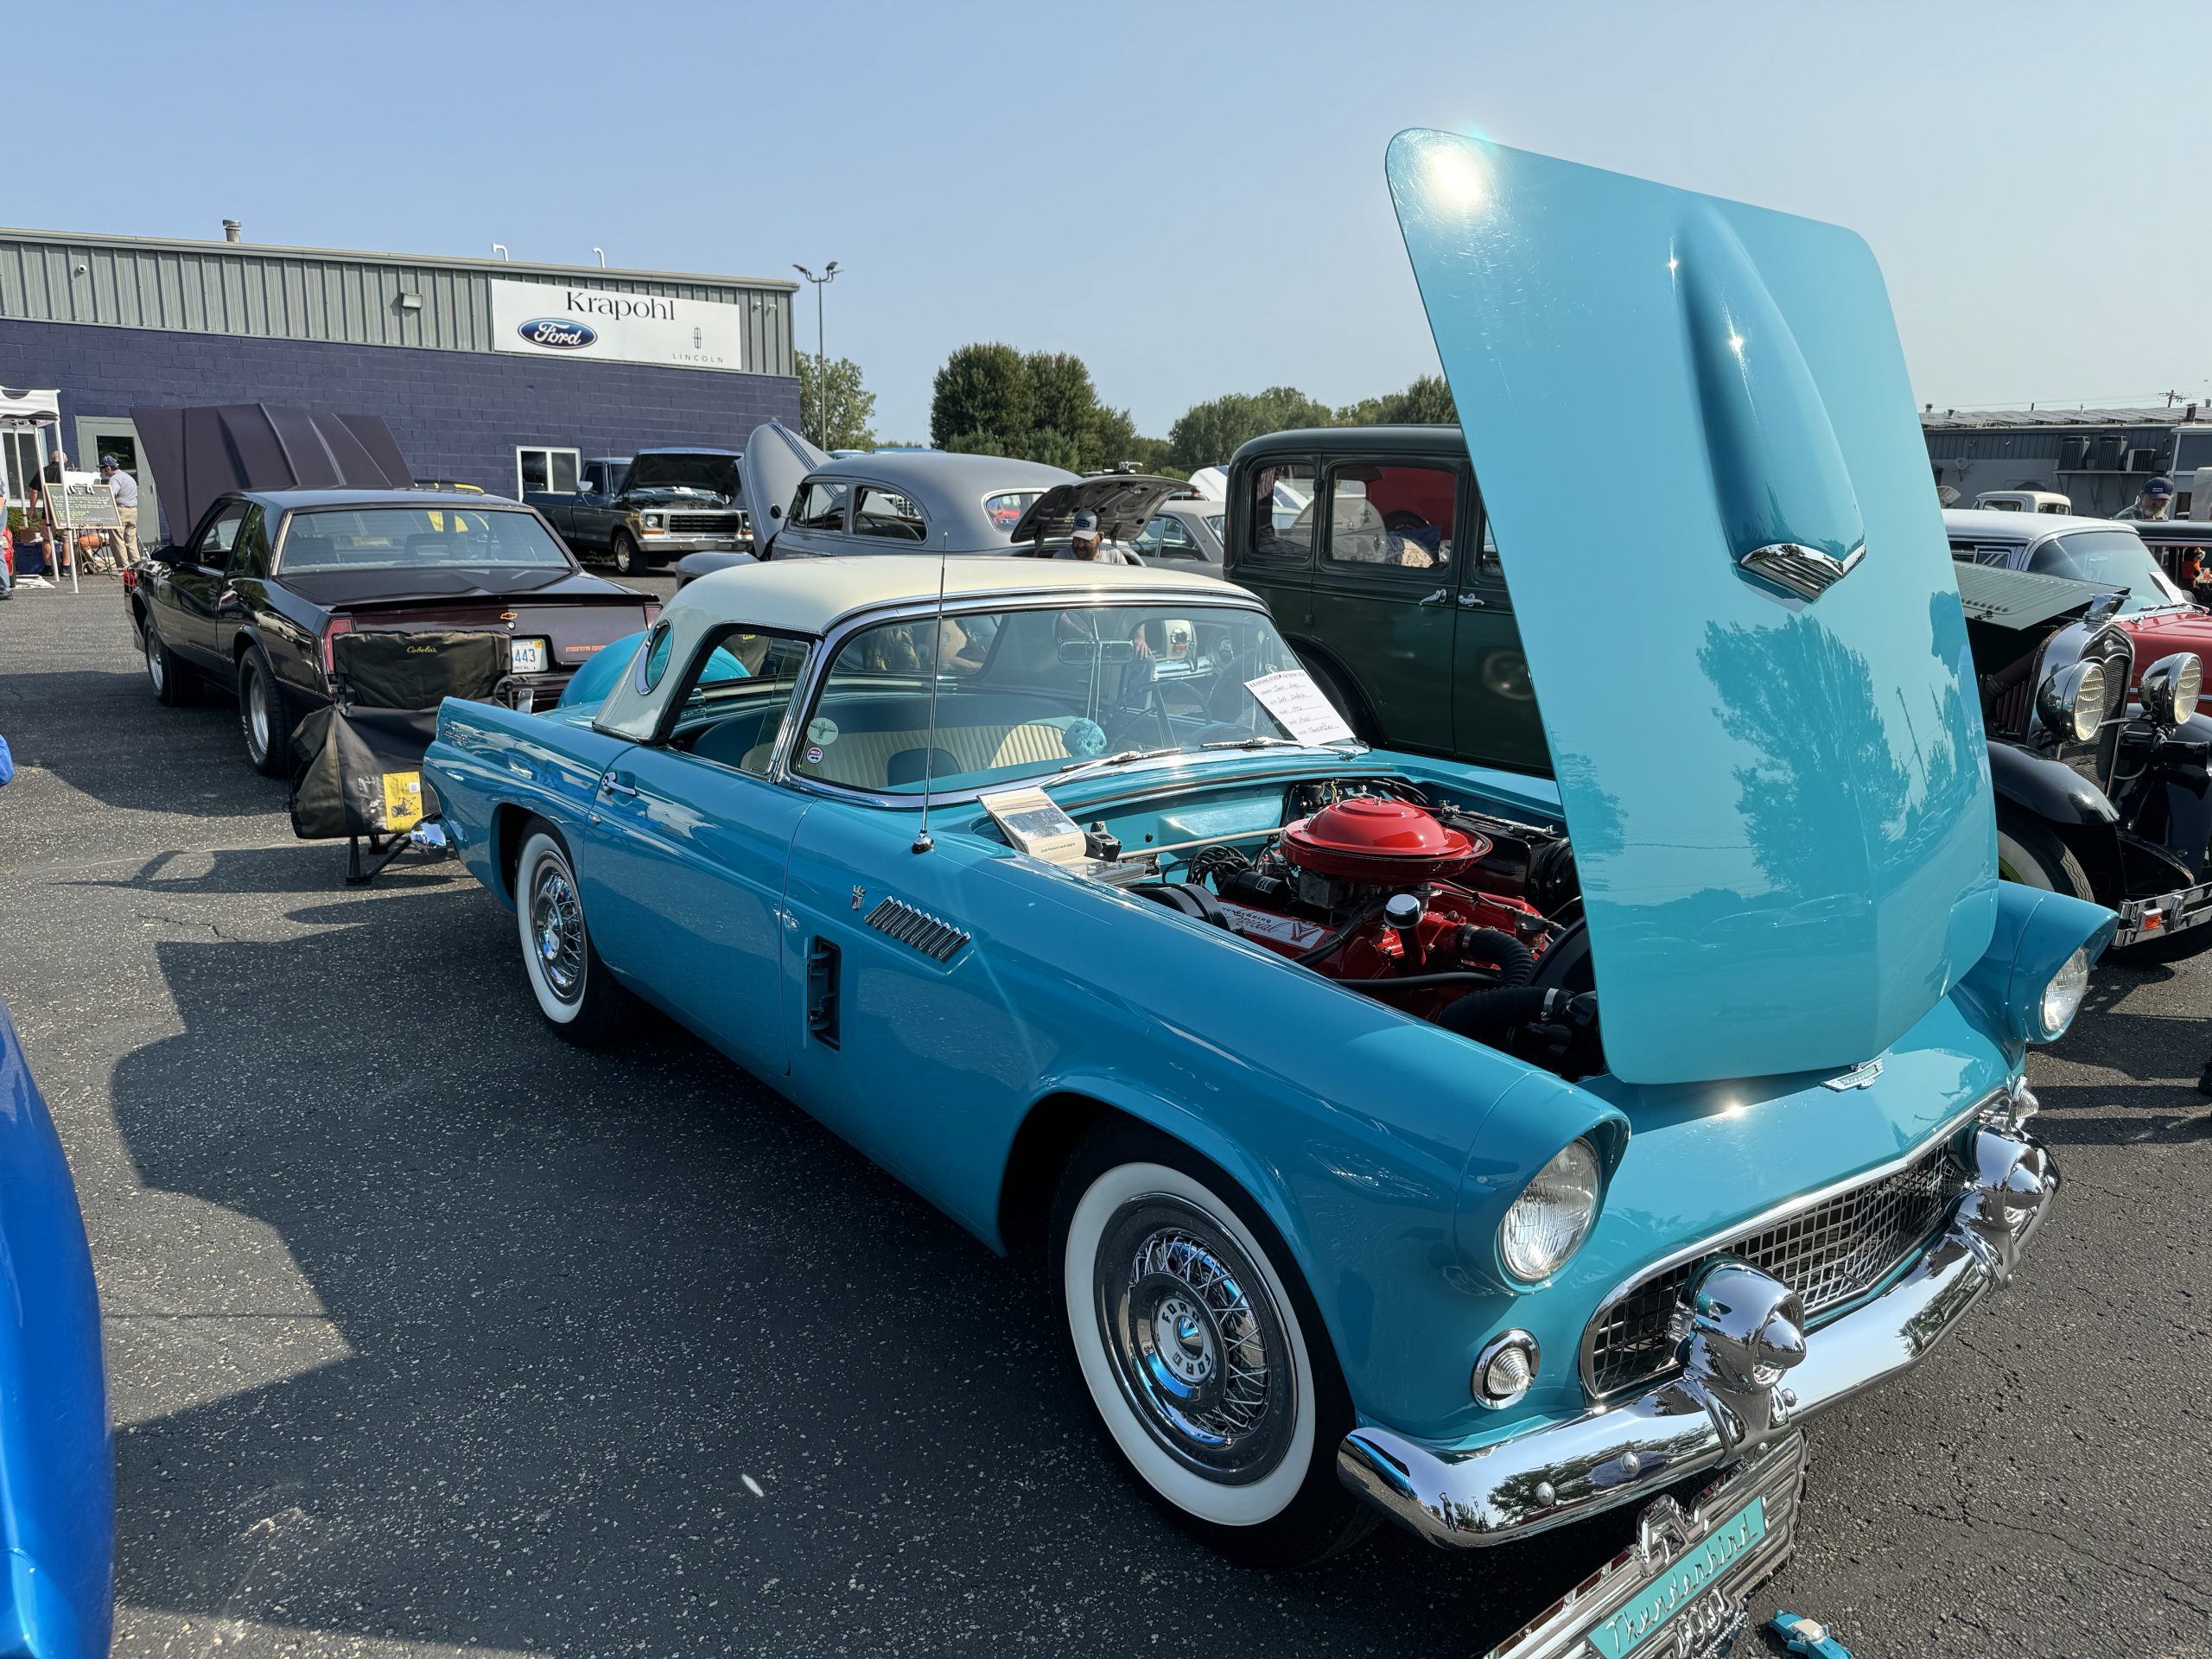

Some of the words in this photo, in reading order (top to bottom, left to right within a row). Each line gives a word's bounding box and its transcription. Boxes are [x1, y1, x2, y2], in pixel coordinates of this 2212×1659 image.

[566, 291, 675, 321] Krapohl
[533, 321, 582, 346] Ford
[672, 353, 724, 364] LINCOLN
[512, 648, 536, 663] 443
[1161, 1301, 1201, 1325] FORD
[1605, 1512, 1758, 1652] Thunderbird
